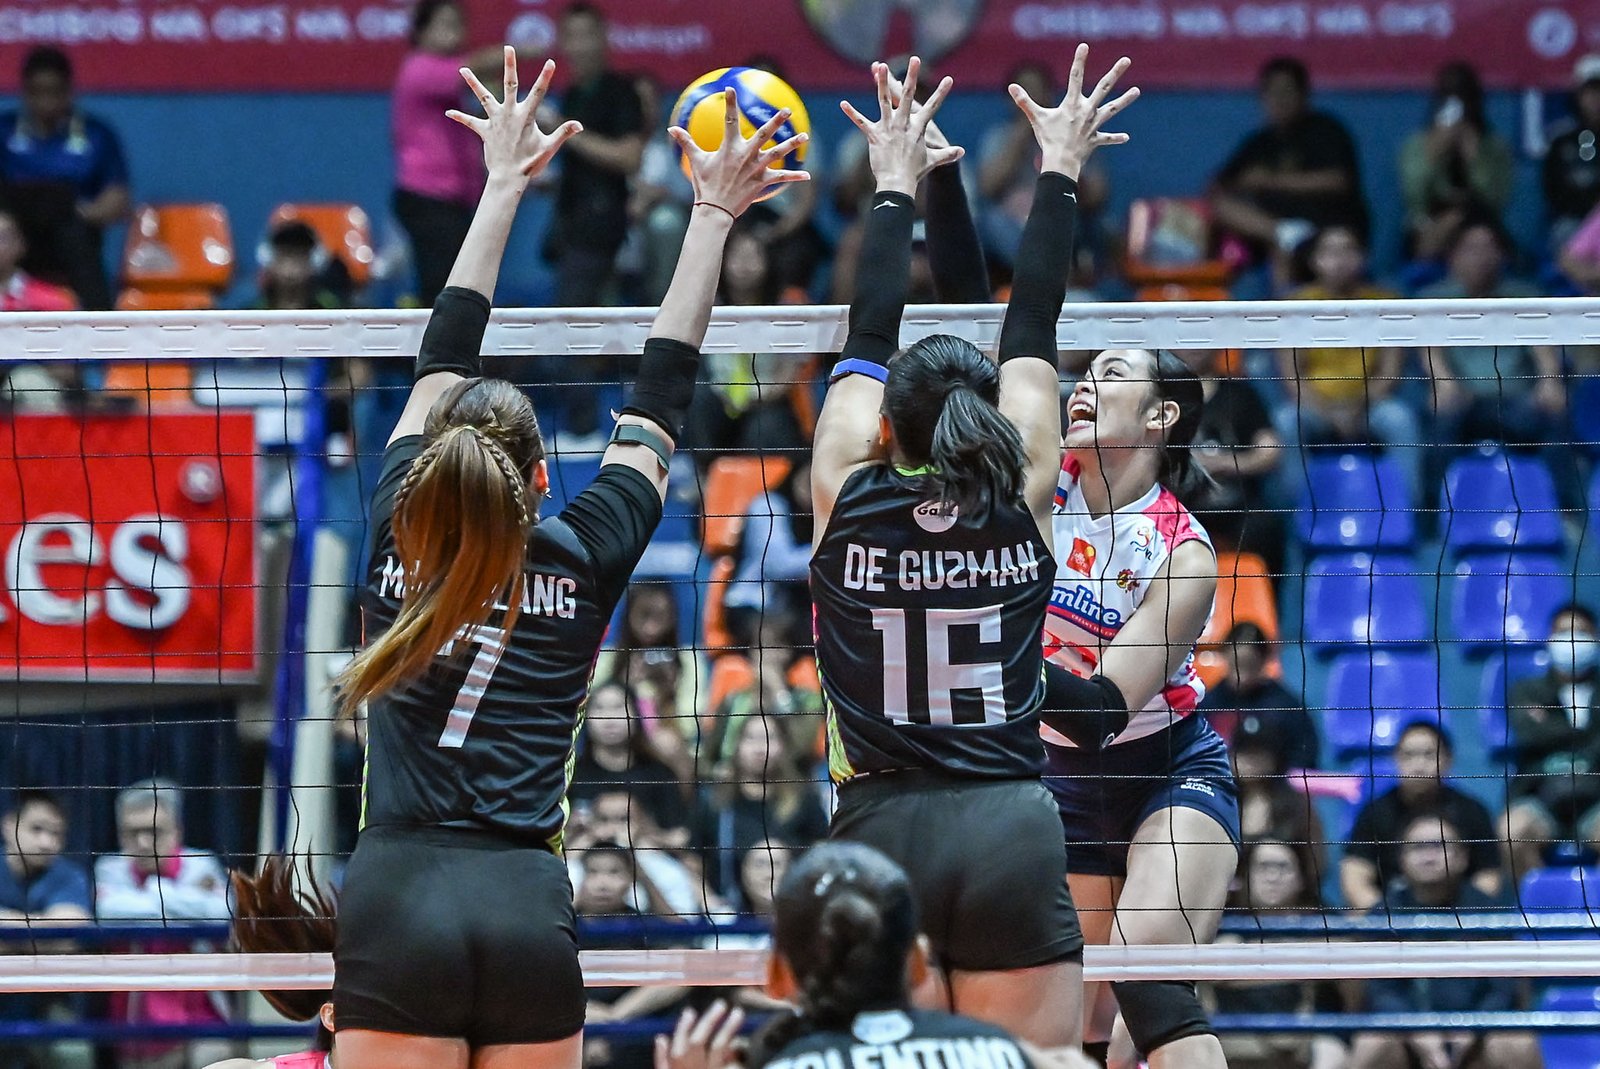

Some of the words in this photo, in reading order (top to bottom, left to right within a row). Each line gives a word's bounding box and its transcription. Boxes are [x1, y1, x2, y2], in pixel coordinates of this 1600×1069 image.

[0, 512, 191, 629] es
[844, 543, 887, 592] DE
[899, 540, 1039, 591] GUZMAN
[437, 623, 507, 748] 7
[870, 603, 1008, 727] 16
[762, 1036, 1027, 1069] ENTINO
